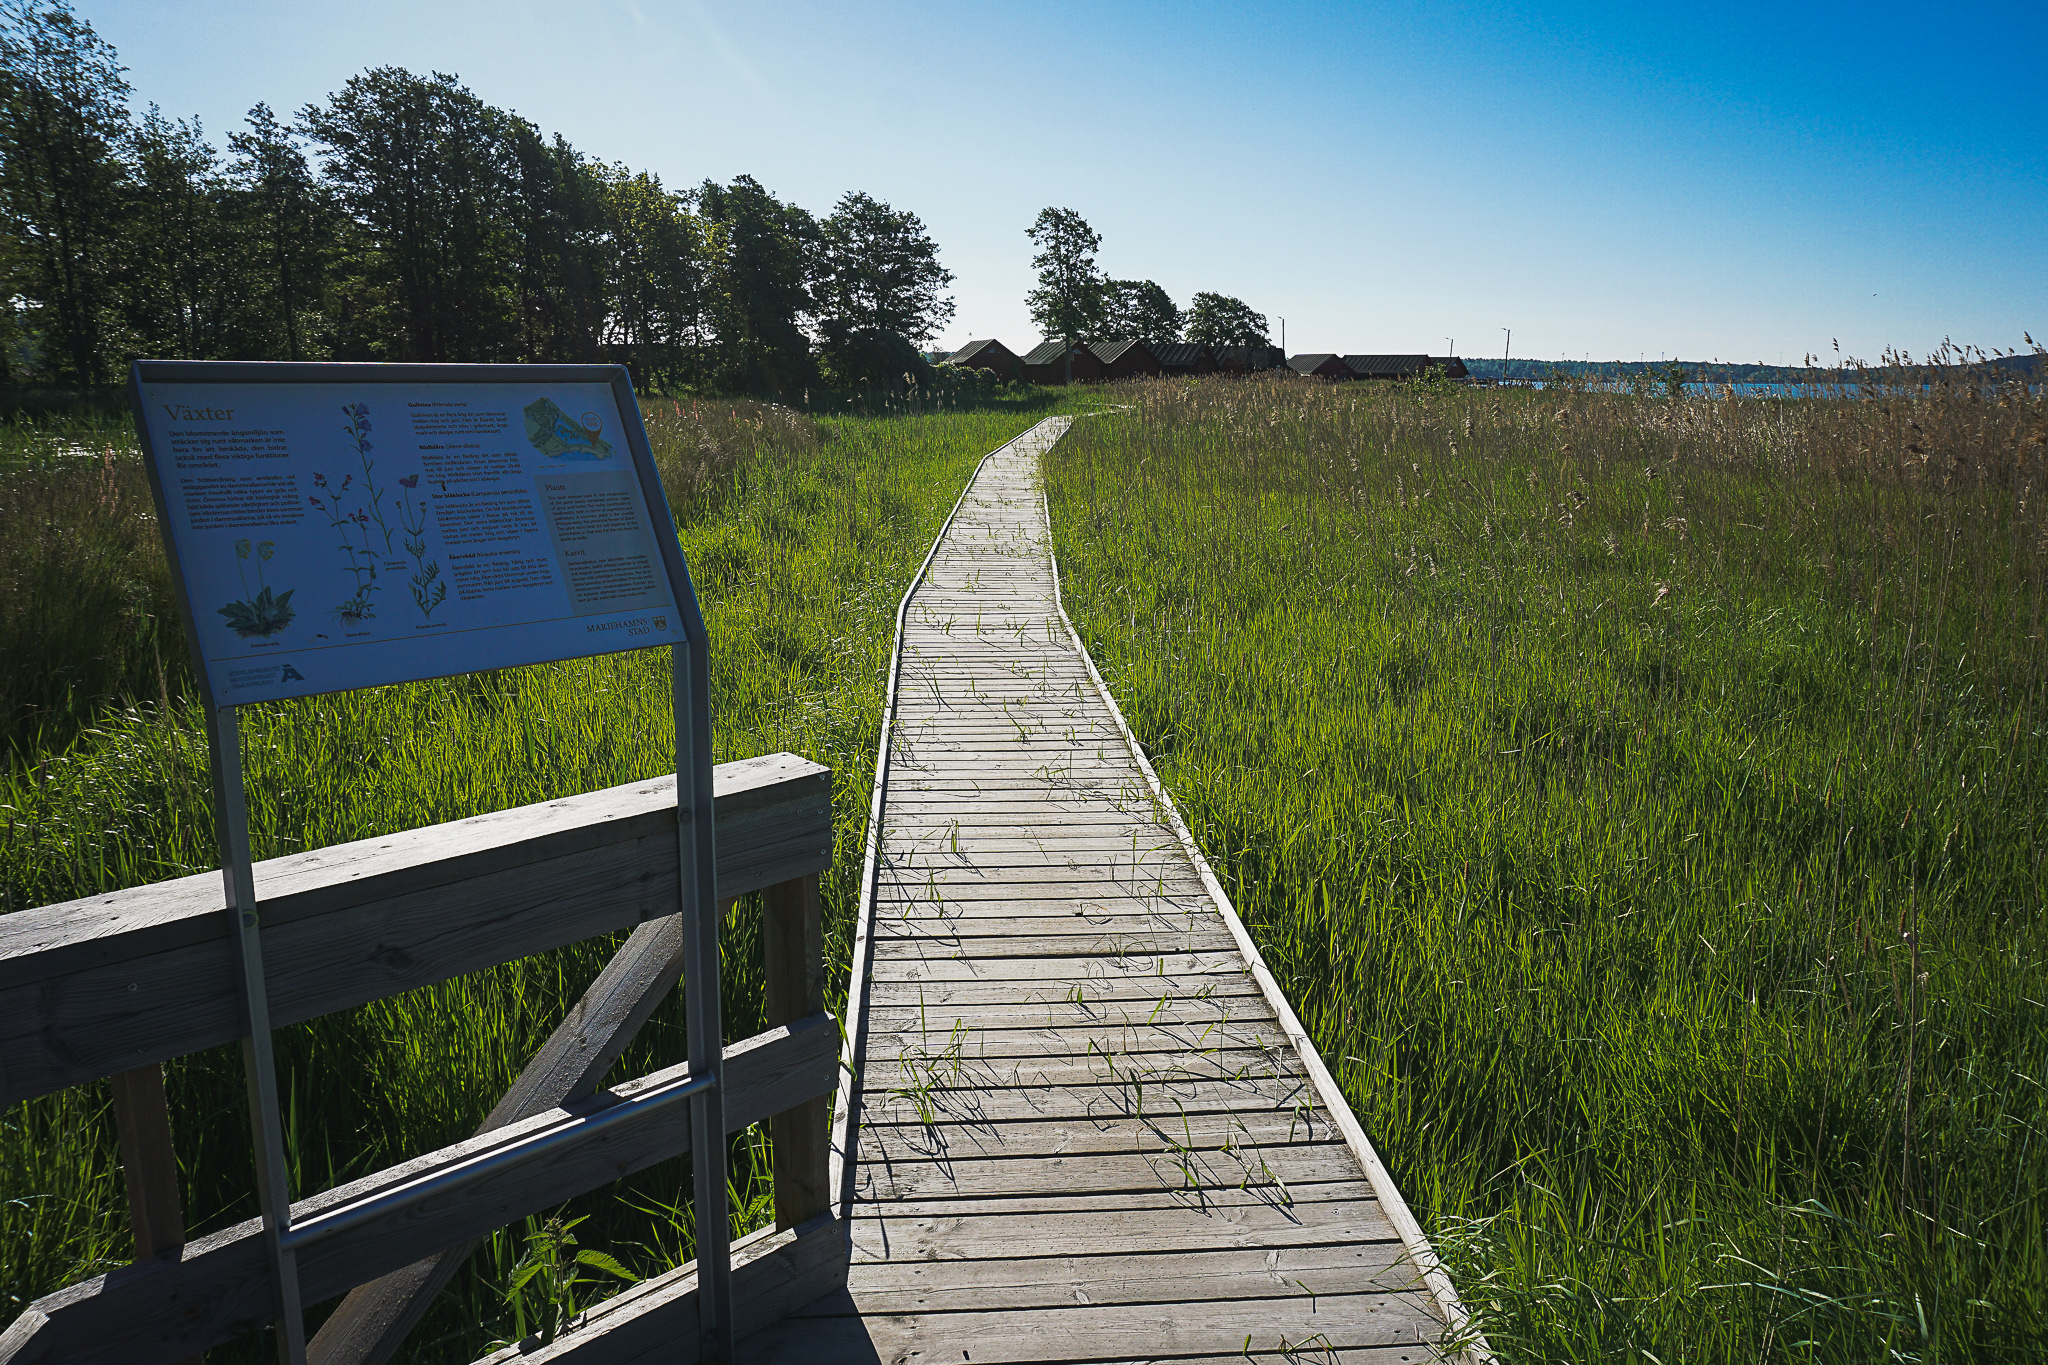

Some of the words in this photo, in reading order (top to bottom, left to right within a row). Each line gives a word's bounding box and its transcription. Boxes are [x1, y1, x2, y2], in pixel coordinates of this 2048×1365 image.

[162, 404, 234, 420] Växter
[586, 618, 647, 632] MARIEHAMNS
[629, 627, 650, 636] STAD
